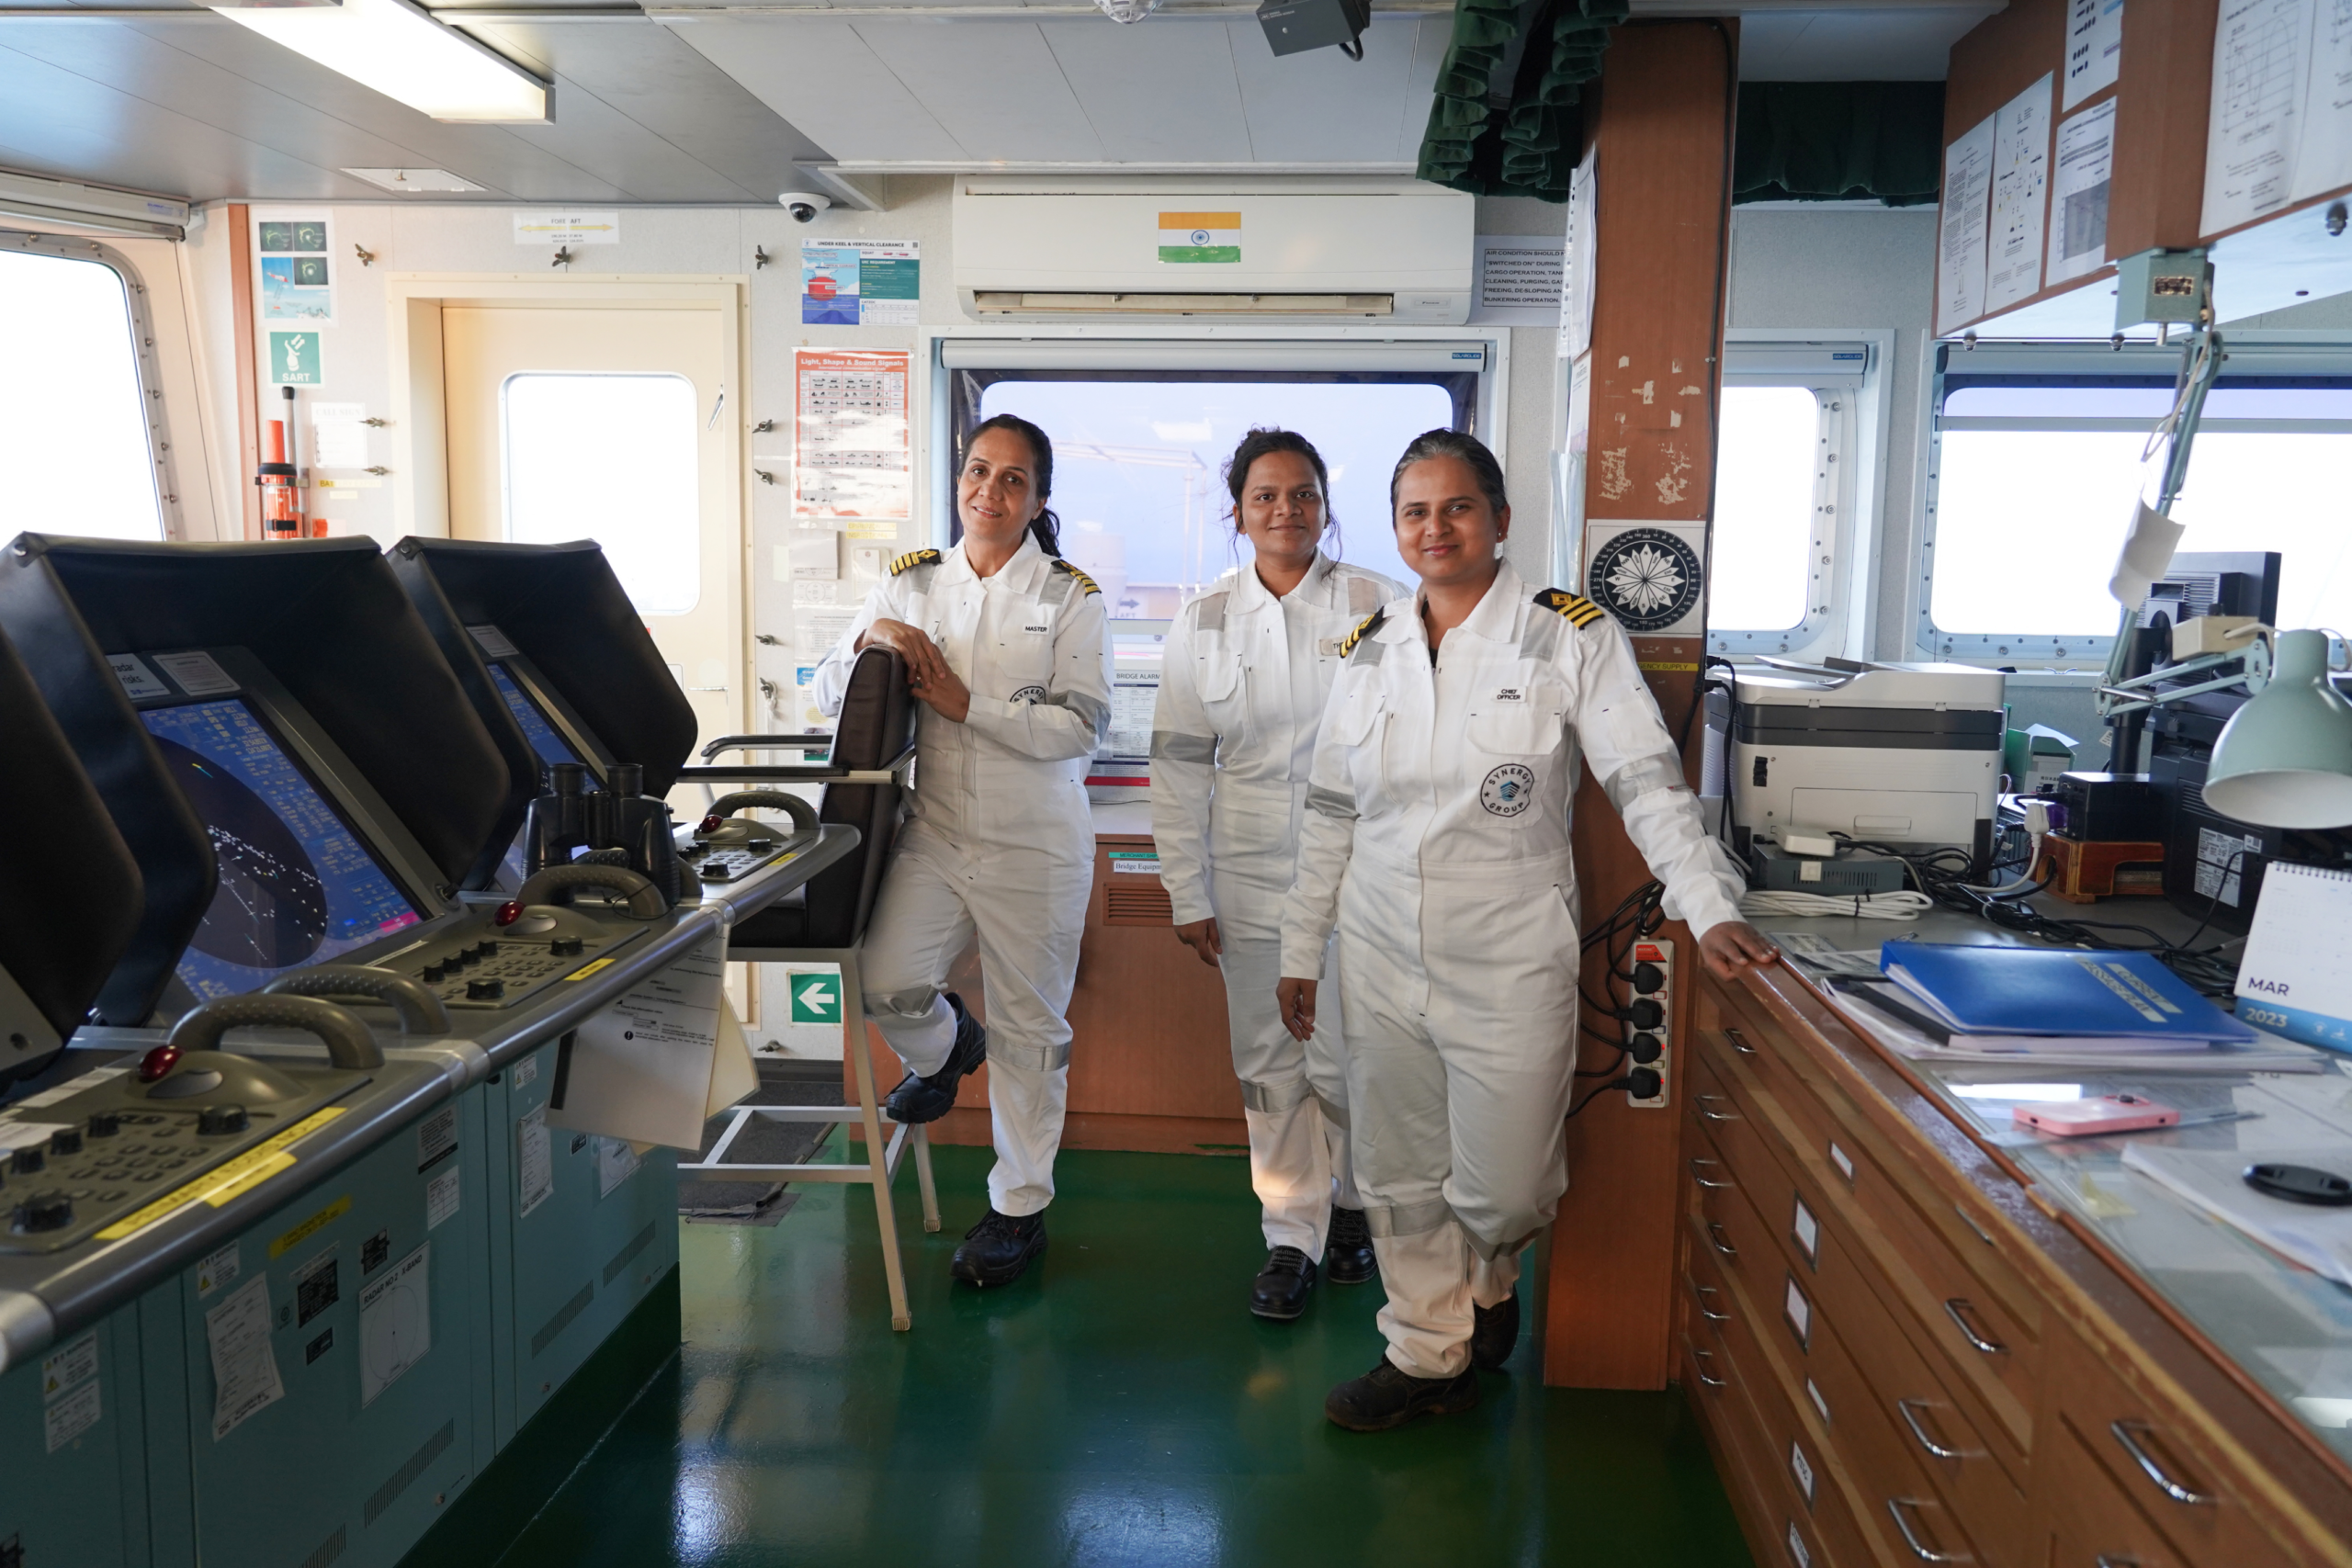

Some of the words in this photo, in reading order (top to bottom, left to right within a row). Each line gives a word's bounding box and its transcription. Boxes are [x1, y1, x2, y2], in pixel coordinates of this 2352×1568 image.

[823, 358, 844, 367] Shape
[282, 373, 311, 382] SART
[112, 663, 134, 672] radar
[122, 674, 145, 684] risks.
[1013, 689, 1044, 702] SYNERGY
[1488, 767, 1531, 785] SYNERGY
[1489, 802, 1524, 813] GROUP
[1115, 863, 1136, 871] Bridge
[2248, 976, 2290, 997] MAR
[2245, 1007, 2289, 1028] 2023
[364, 1283, 384, 1304] RADAR
[385, 1276, 394, 1288] NO
[394, 1272, 399, 1281] 2
[401, 1254, 423, 1275] X-BAND
